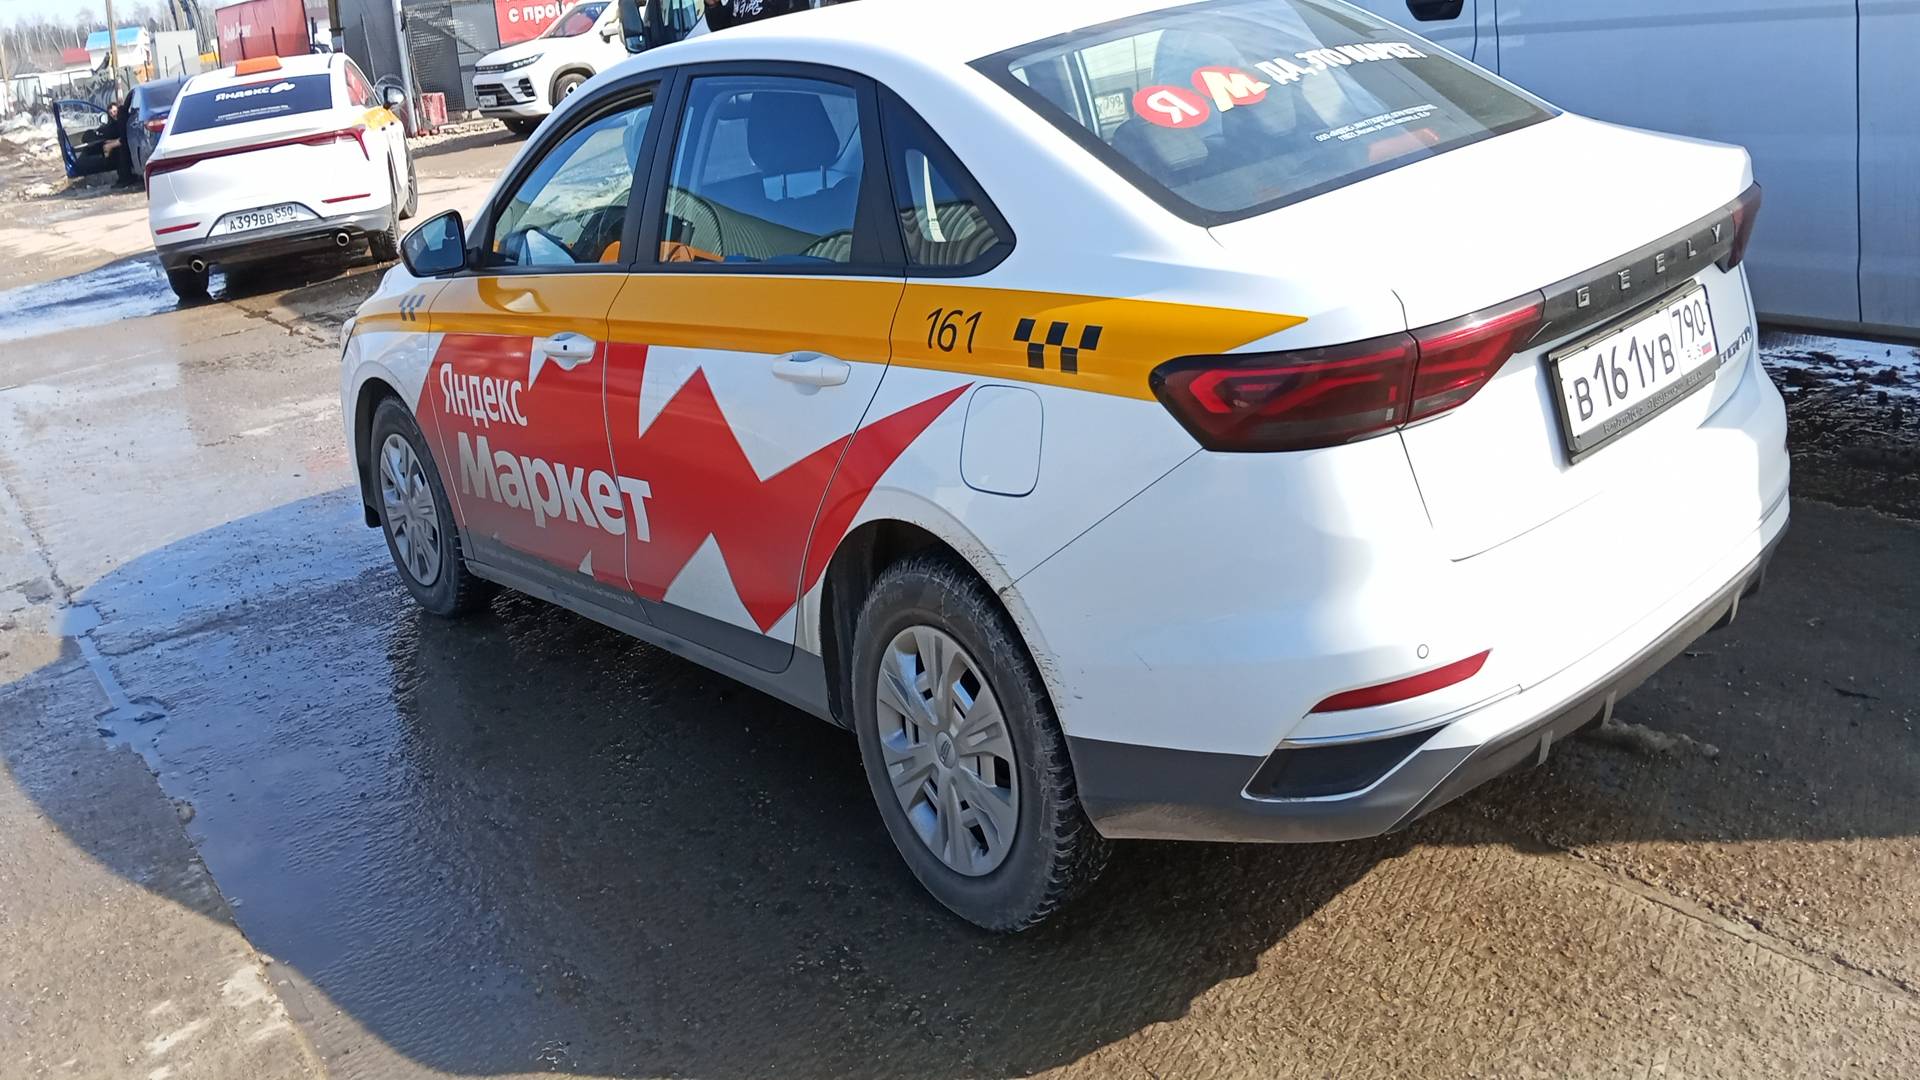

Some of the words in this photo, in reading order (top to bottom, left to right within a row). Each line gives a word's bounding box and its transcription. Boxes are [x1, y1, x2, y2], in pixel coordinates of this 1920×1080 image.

[508, 7, 520, 23] с
[1147, 90, 1200, 124] Я
[274, 205, 294, 219] 550
[1576, 223, 1722, 309] GEELY
[926, 307, 983, 354] 161
[1573, 333, 1676, 422] В161УВ
[1671, 299, 1706, 349] 790
[439, 362, 528, 429] Яндекс
[457, 431, 653, 543] Маркет
